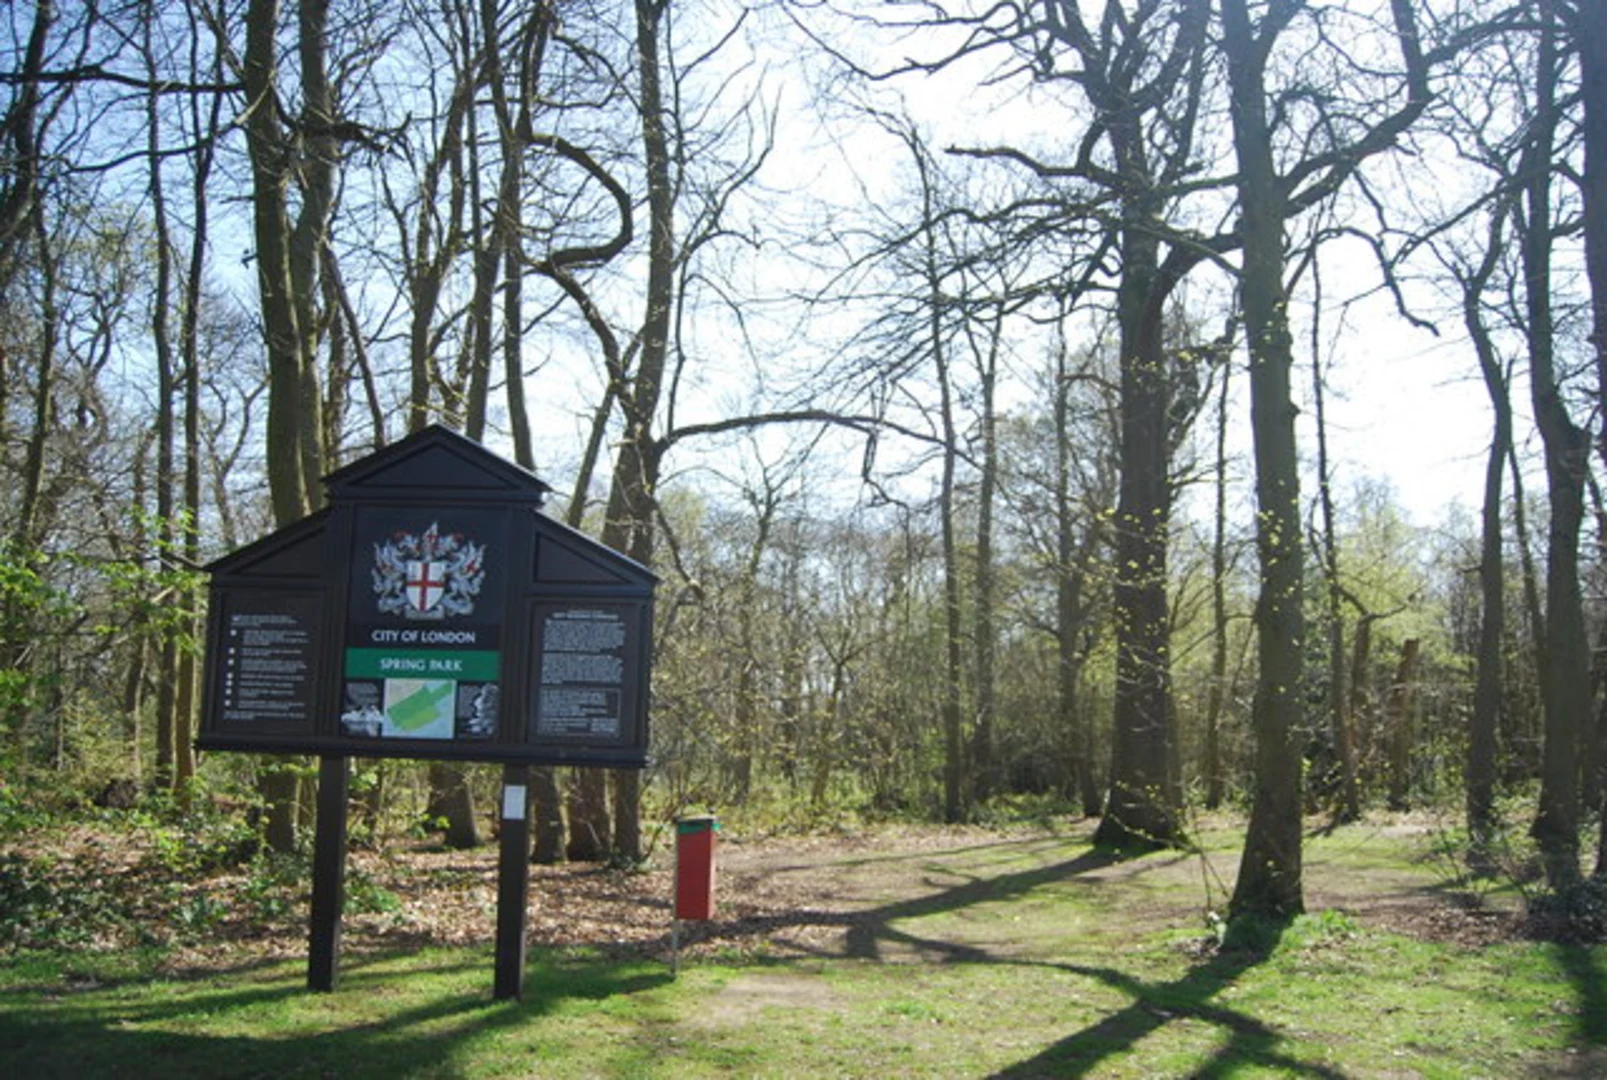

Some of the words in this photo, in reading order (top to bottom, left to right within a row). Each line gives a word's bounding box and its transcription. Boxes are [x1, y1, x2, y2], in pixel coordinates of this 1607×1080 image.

[371, 629, 399, 642] CITY
[401, 630, 418, 642] OF
[421, 631, 476, 644] LONDON
[380, 658, 426, 671] SPRING
[429, 659, 463, 672] PARK
